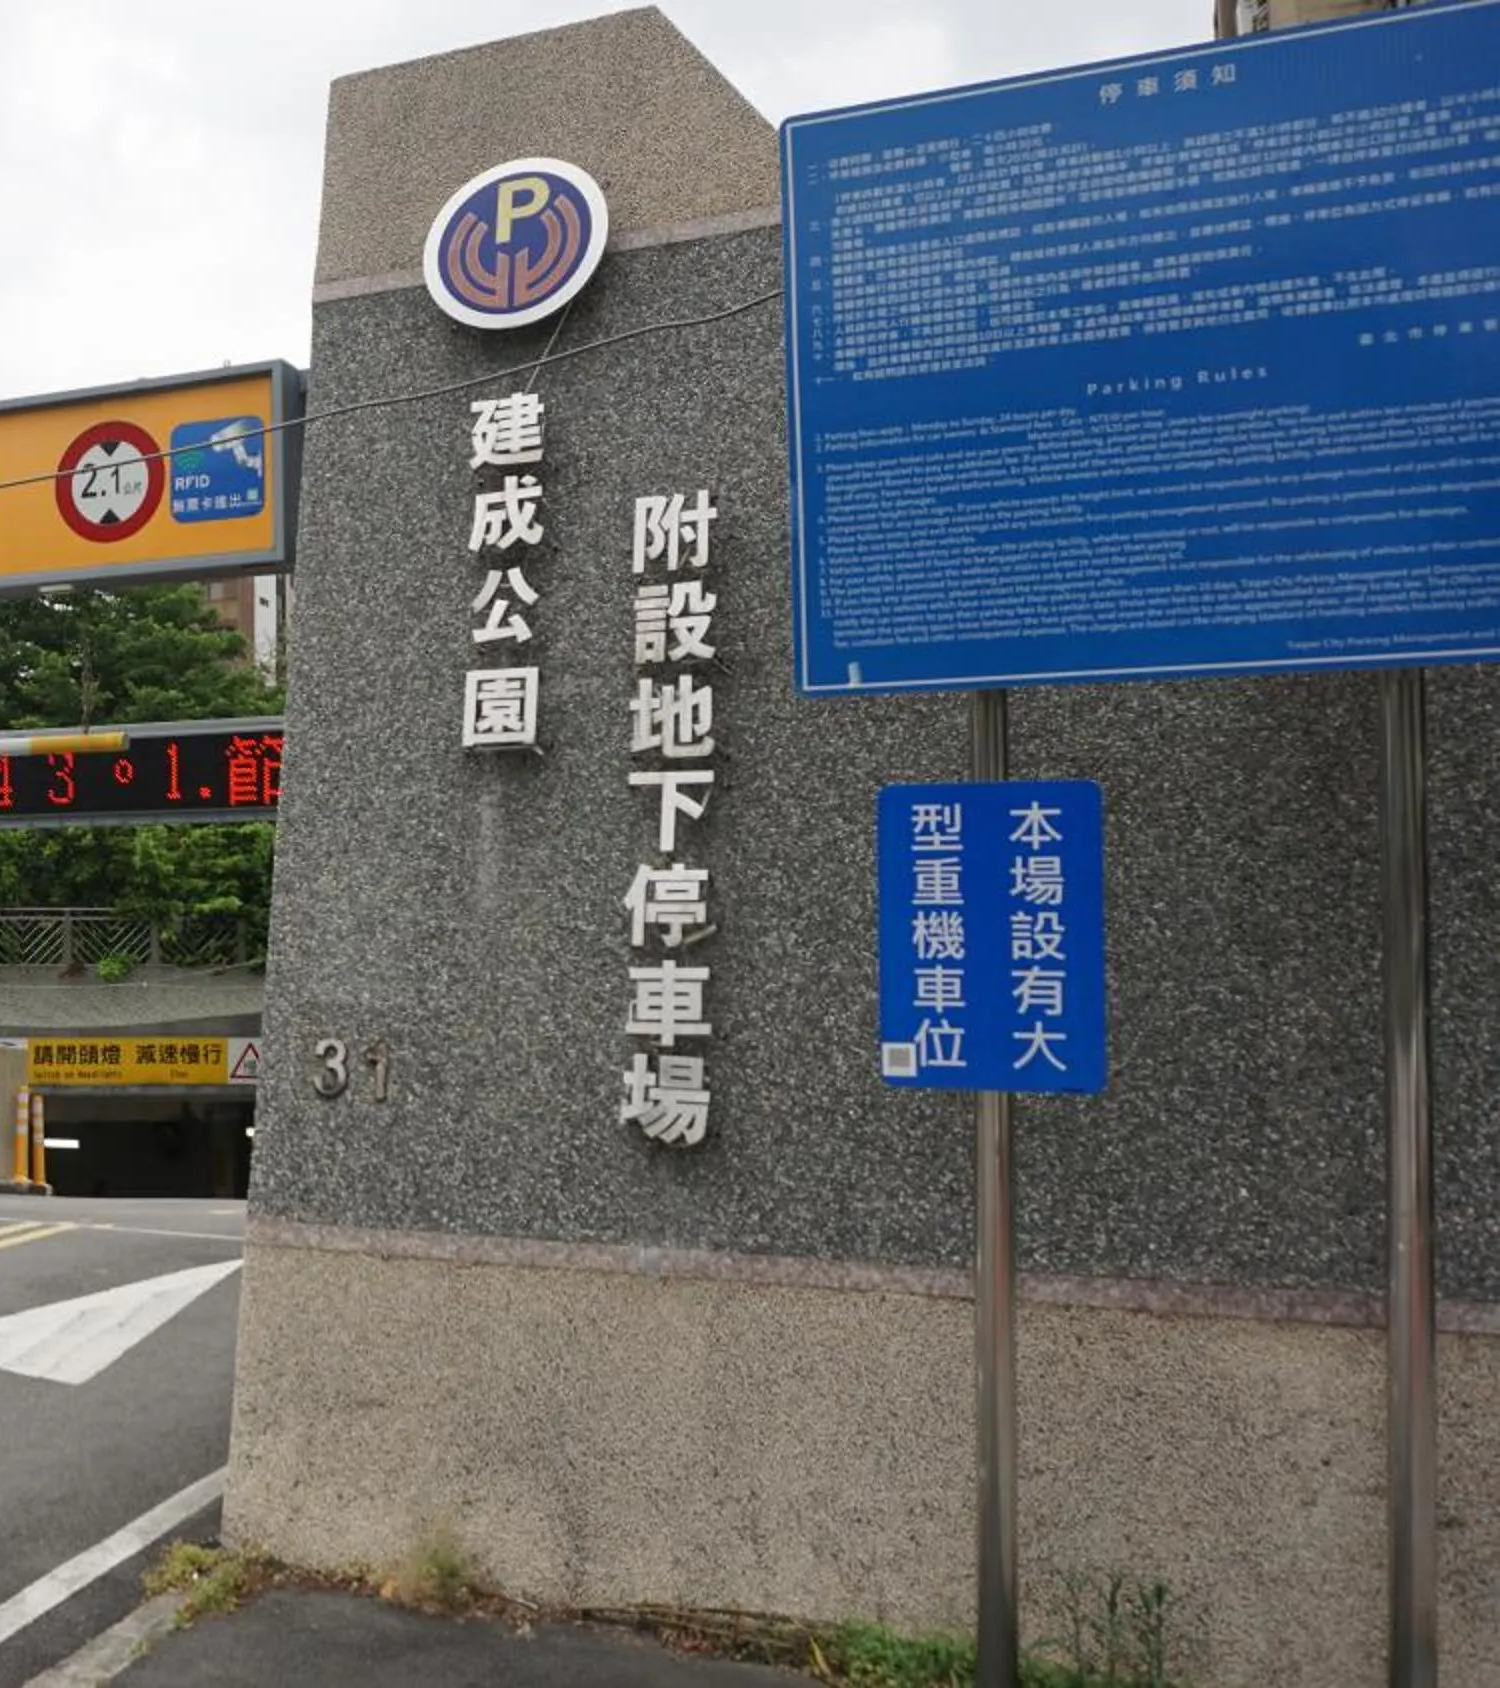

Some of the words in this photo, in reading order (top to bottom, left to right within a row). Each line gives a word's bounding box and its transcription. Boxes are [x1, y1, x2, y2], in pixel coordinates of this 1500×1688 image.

[1100, 64, 1236, 104] 停車須知
[495, 176, 550, 244] P
[1087, 376, 1183, 396] Parking
[1197, 367, 1268, 383] Rules
[175, 475, 210, 491] RFID
[462, 392, 544, 747] 建成公園
[620, 490, 717, 1145] 附設地下停車場
[911, 803, 967, 1068] 型重機車位
[1009, 801, 1068, 1072] 本場設有大
[135, 1043, 221, 1065] 減速慢行
[312, 1037, 390, 1099] 31
